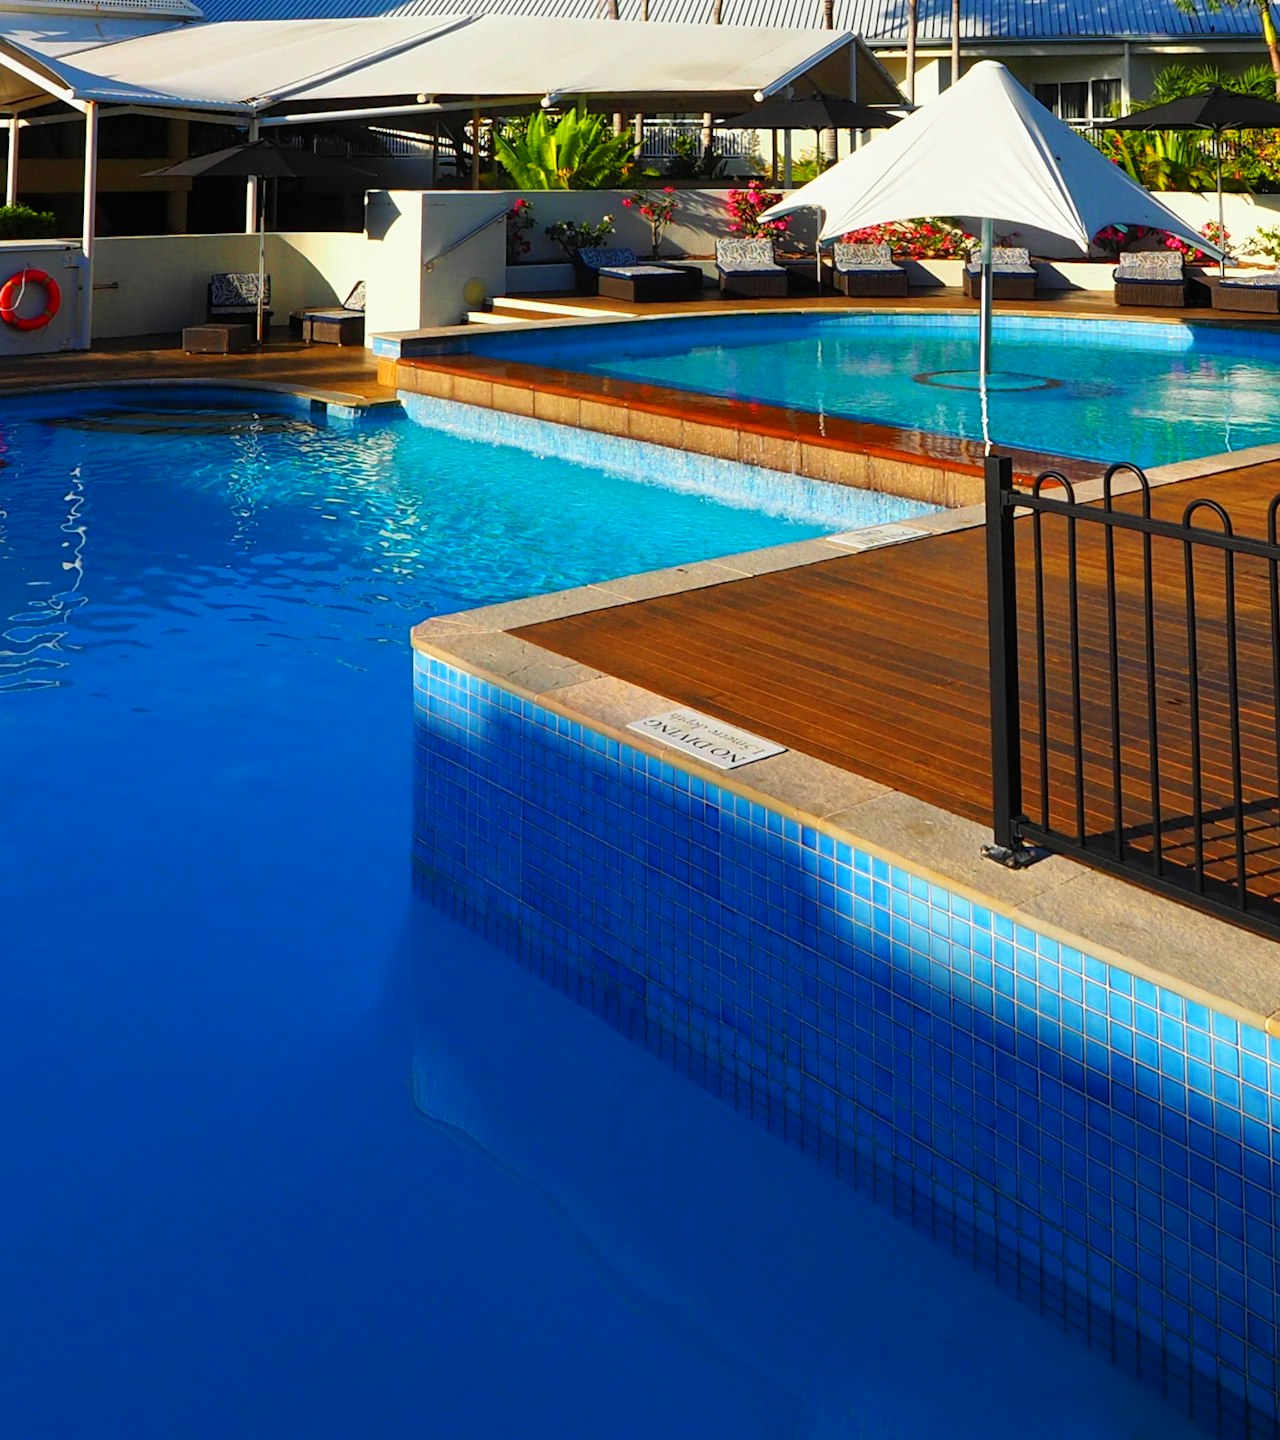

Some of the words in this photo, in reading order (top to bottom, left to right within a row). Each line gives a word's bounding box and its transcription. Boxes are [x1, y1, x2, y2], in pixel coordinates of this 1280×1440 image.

[669, 712, 709, 732] depth
[643, 719, 711, 750] DIVING
[711, 747, 747, 764] NO
